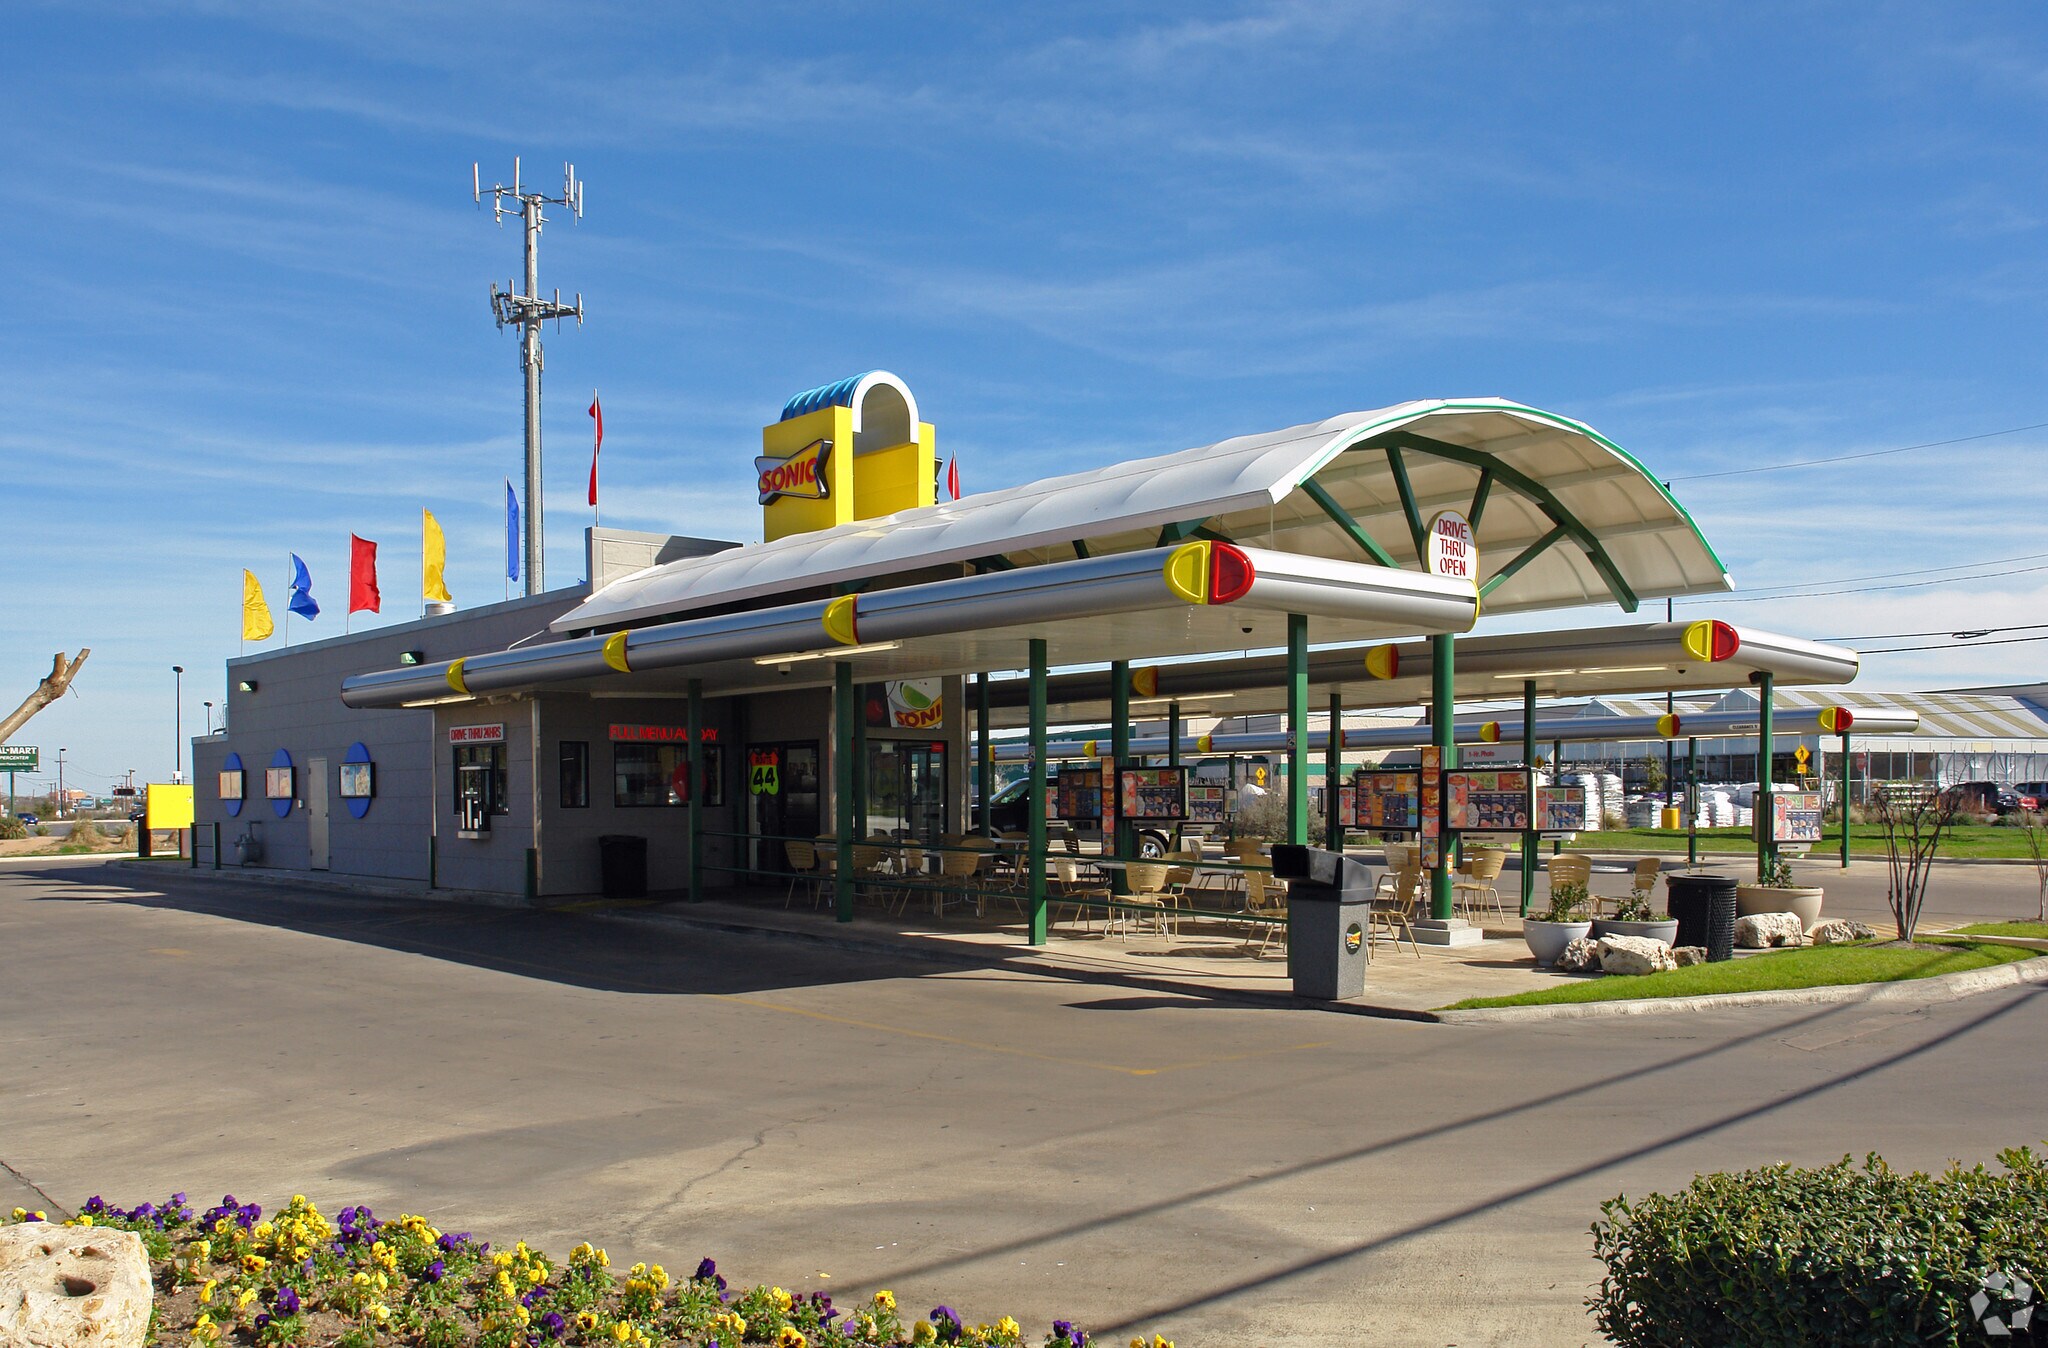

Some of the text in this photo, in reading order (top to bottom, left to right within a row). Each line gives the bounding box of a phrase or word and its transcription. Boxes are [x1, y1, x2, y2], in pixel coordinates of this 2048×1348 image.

[761, 457, 817, 494] SONIC
[1438, 518, 1467, 539] DRIVE
[1440, 538, 1466, 557] THRU
[1440, 557, 1466, 576] OPEN
[895, 704, 941, 727] SONI
[450, 728, 467, 740] DRIVE
[468, 727, 482, 739] THRU
[609, 725, 638, 740] FULL
[640, 726, 673, 741] MENU
[753, 767, 775, 787] 44
